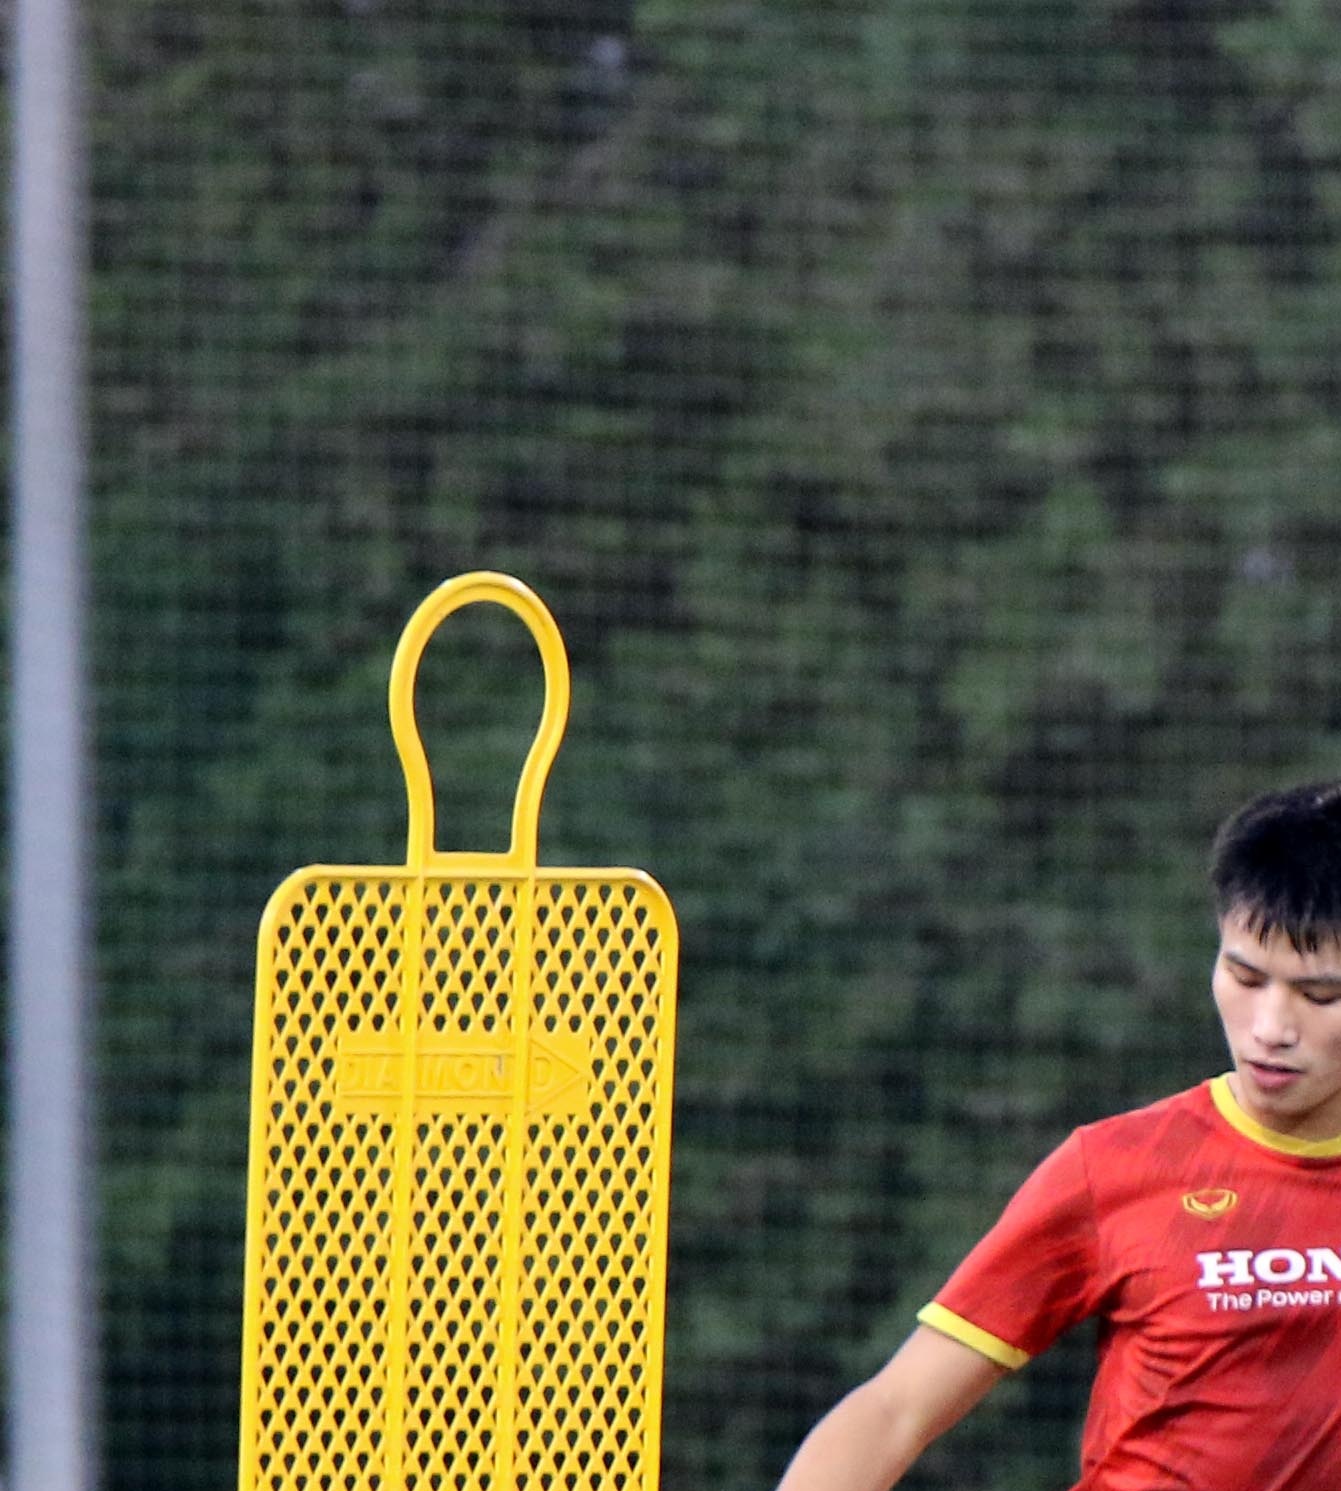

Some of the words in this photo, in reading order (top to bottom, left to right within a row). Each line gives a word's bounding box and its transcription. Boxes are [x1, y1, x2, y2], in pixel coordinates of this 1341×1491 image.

[342, 1056, 553, 1093] DIAMOND
[1206, 1291, 1253, 1312] The
[1256, 1288, 1334, 1309] Power
